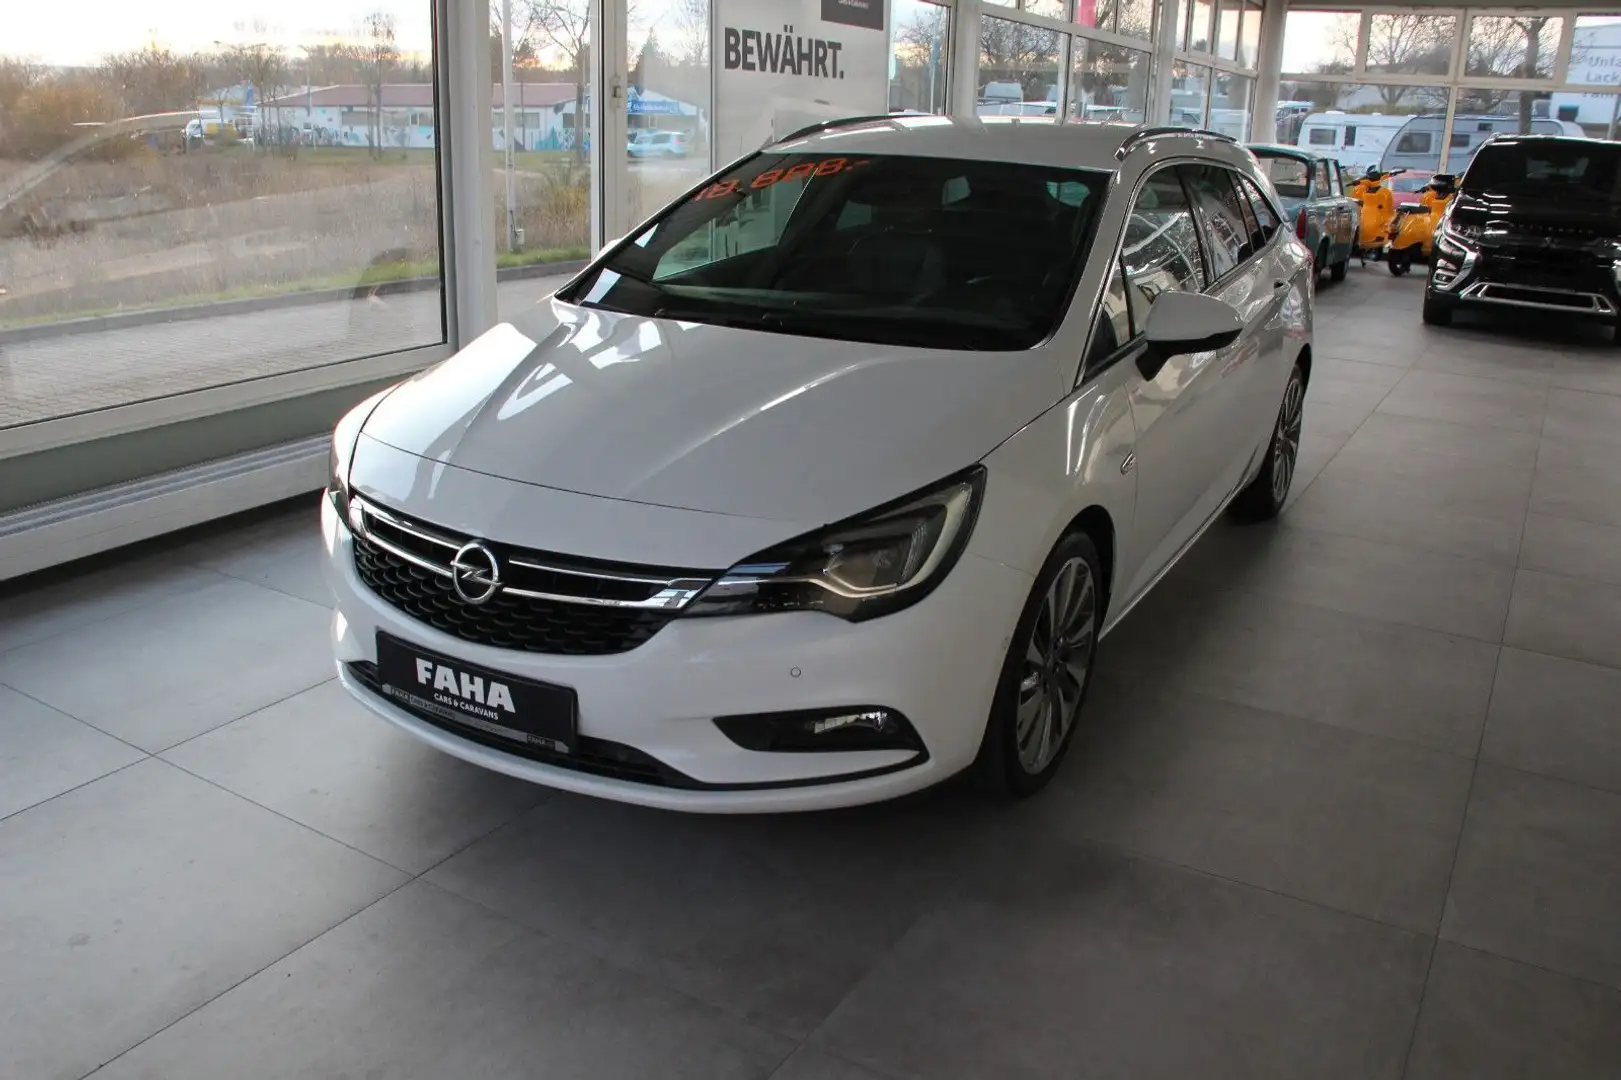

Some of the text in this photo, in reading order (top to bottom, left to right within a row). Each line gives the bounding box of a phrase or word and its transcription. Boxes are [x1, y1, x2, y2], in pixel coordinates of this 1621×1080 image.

[724, 25, 845, 80] BEWÄHRT.
[415, 657, 516, 714] FAHA
[433, 692, 453, 706] CARS
[459, 700, 499, 721] CARAVANS
